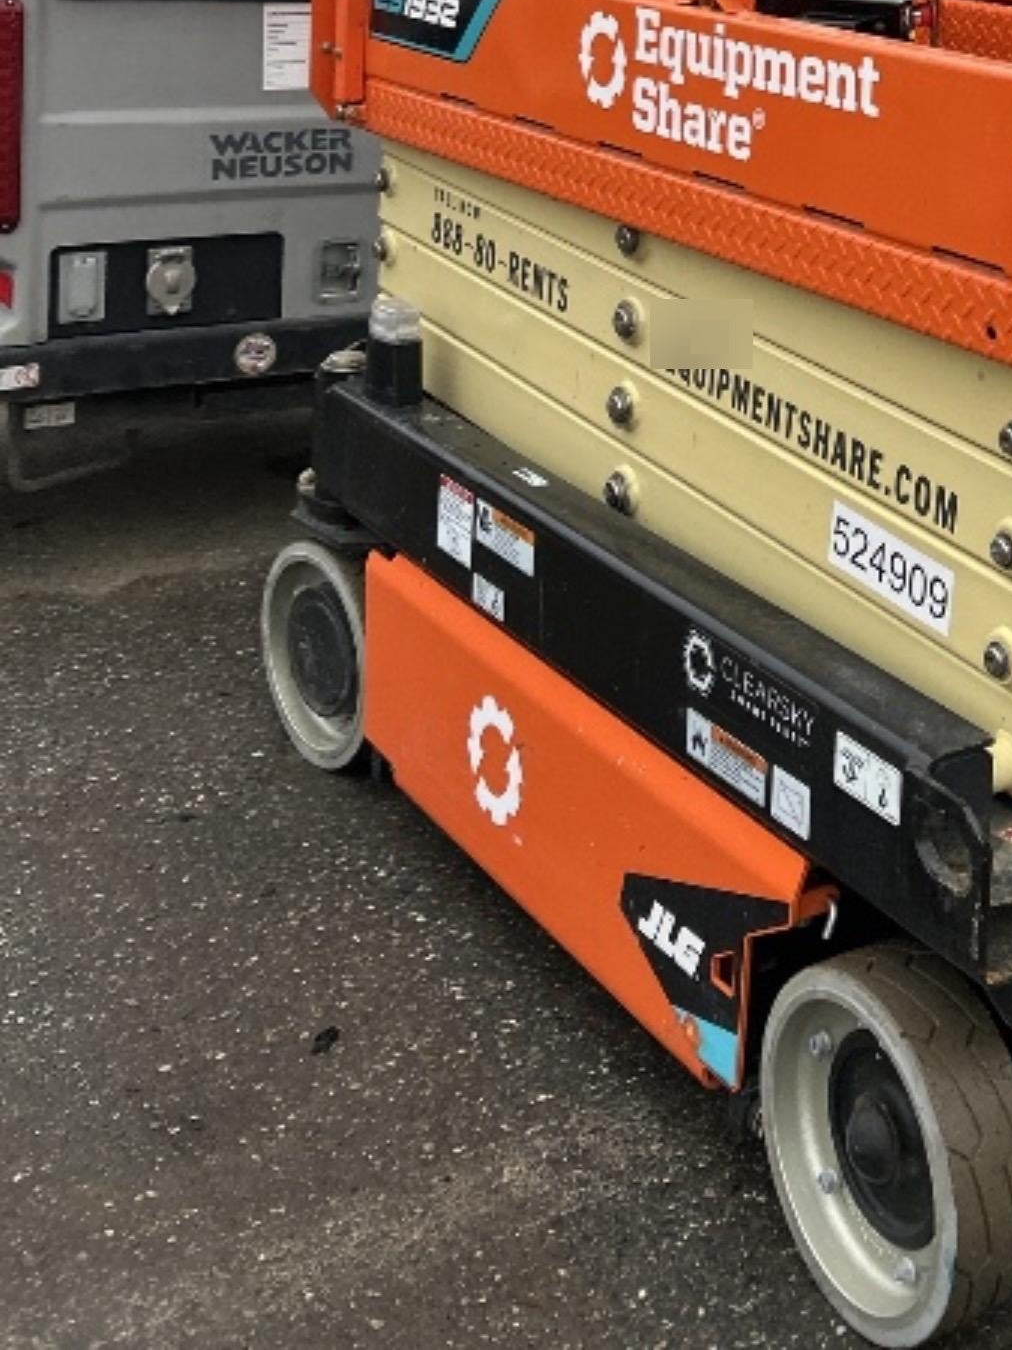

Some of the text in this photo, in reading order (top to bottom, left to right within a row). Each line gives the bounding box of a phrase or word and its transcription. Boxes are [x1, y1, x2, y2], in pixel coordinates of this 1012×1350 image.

[634, 5, 880, 119] Equipment
[209, 128, 354, 156] WACKER
[211, 152, 354, 181] NEUSON
[431, 211, 570, 313] 888-80-RENTS
[664, 368, 959, 535] UIPMENTSHARE.COM
[833, 515, 949, 620] 524909
[720, 655, 816, 737] CLEARSKY
[637, 898, 707, 981] JLG
